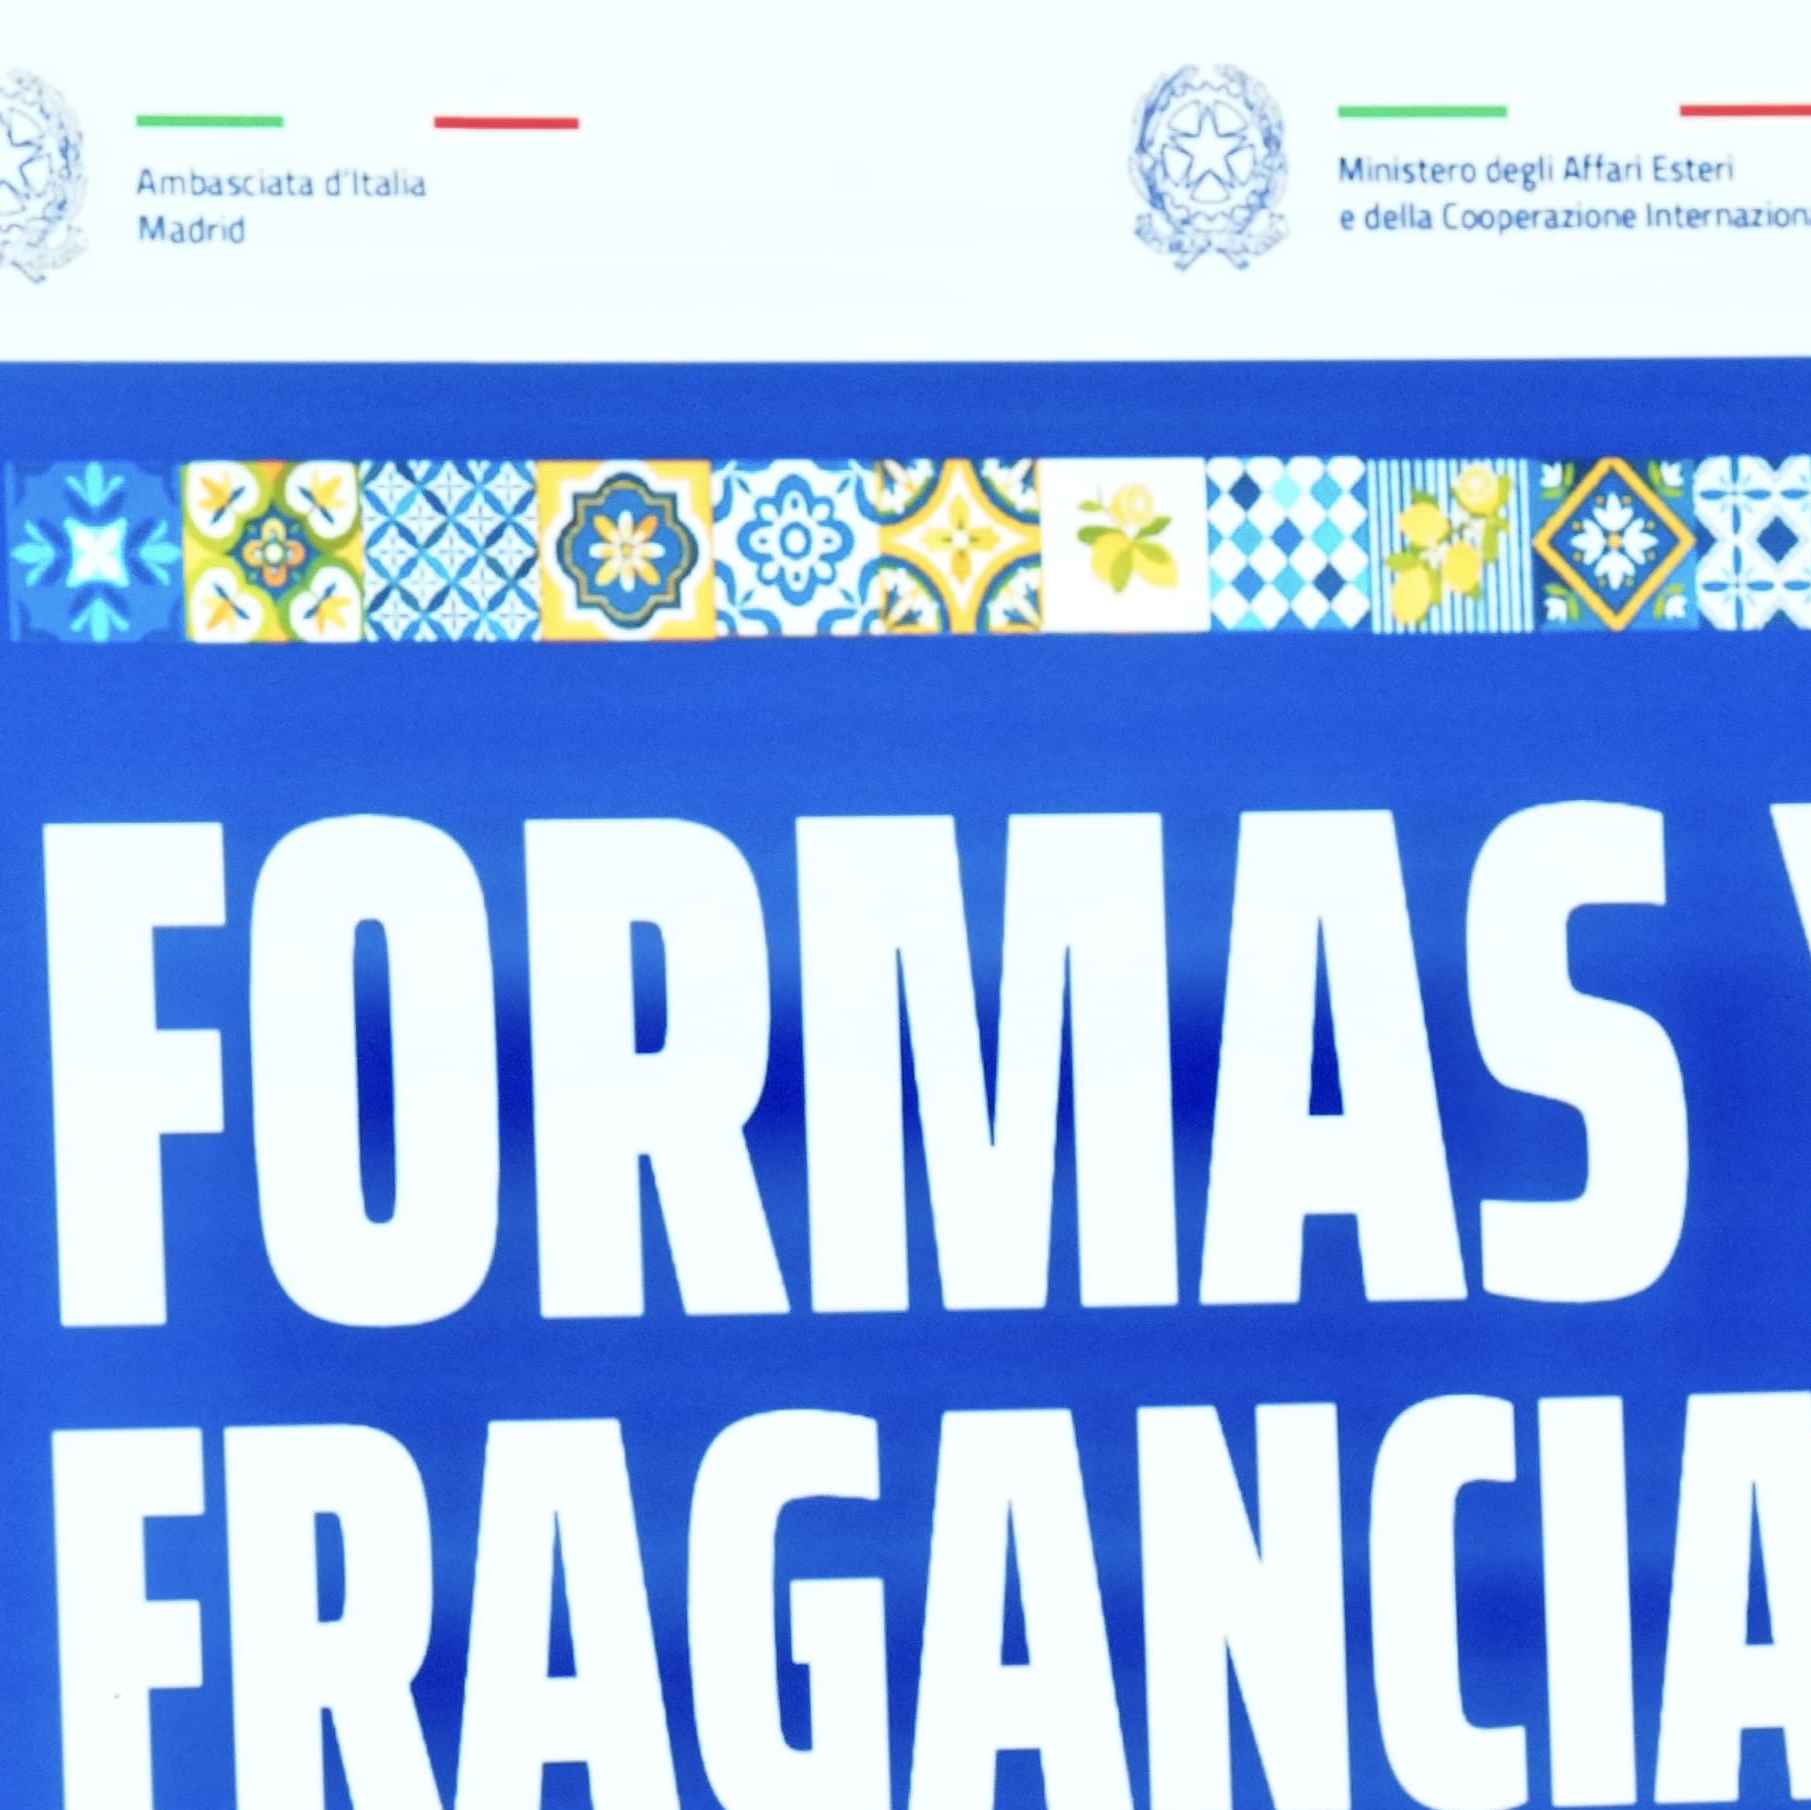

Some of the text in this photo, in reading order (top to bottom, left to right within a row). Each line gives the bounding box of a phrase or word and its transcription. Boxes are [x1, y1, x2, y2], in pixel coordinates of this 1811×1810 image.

[137, 168, 427, 197] Ambasciata d'Italia
[1338, 154, 1736, 192] Ministero degli Affari Esteri
[137, 214, 246, 245] Madrid
[1339, 209, 1355, 231] e
[1364, 202, 1434, 231] della
[1441, 202, 1637, 234] Cooperazione
[43, 799, 1690, 1329] FORMAS
